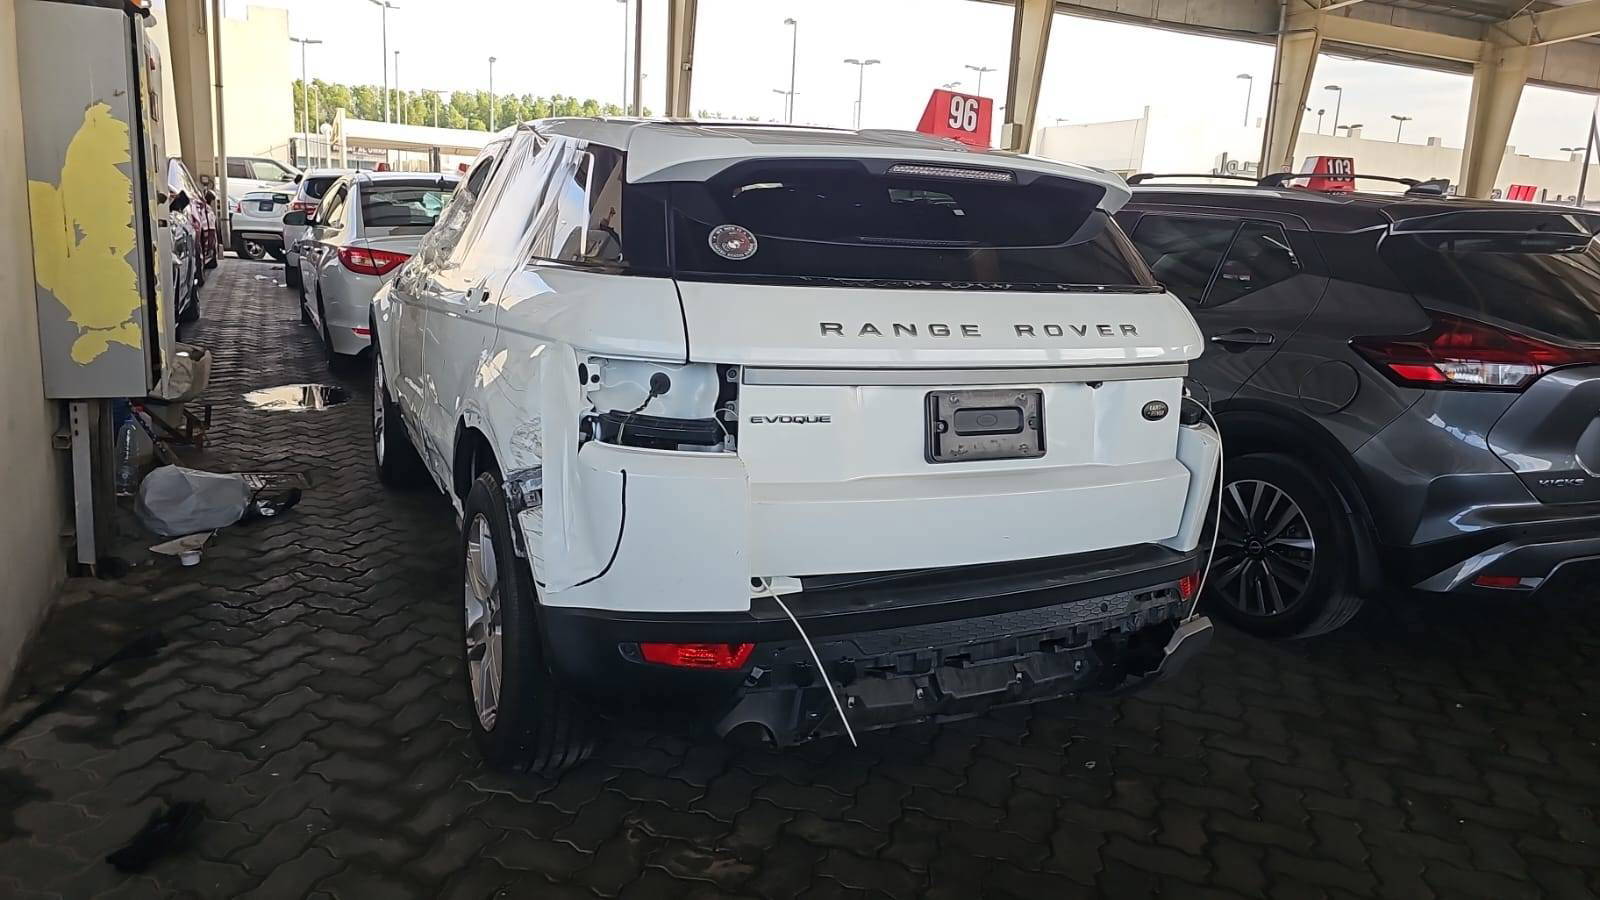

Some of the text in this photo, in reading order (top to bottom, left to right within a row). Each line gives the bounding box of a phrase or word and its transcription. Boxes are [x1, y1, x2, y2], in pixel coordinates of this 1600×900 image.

[948, 95, 979, 132] 96
[1327, 159, 1351, 181] 103
[819, 322, 1139, 338] RANGE ROVER
[750, 414, 831, 425] EVOQUE
[1538, 478, 1585, 488] KICKS
